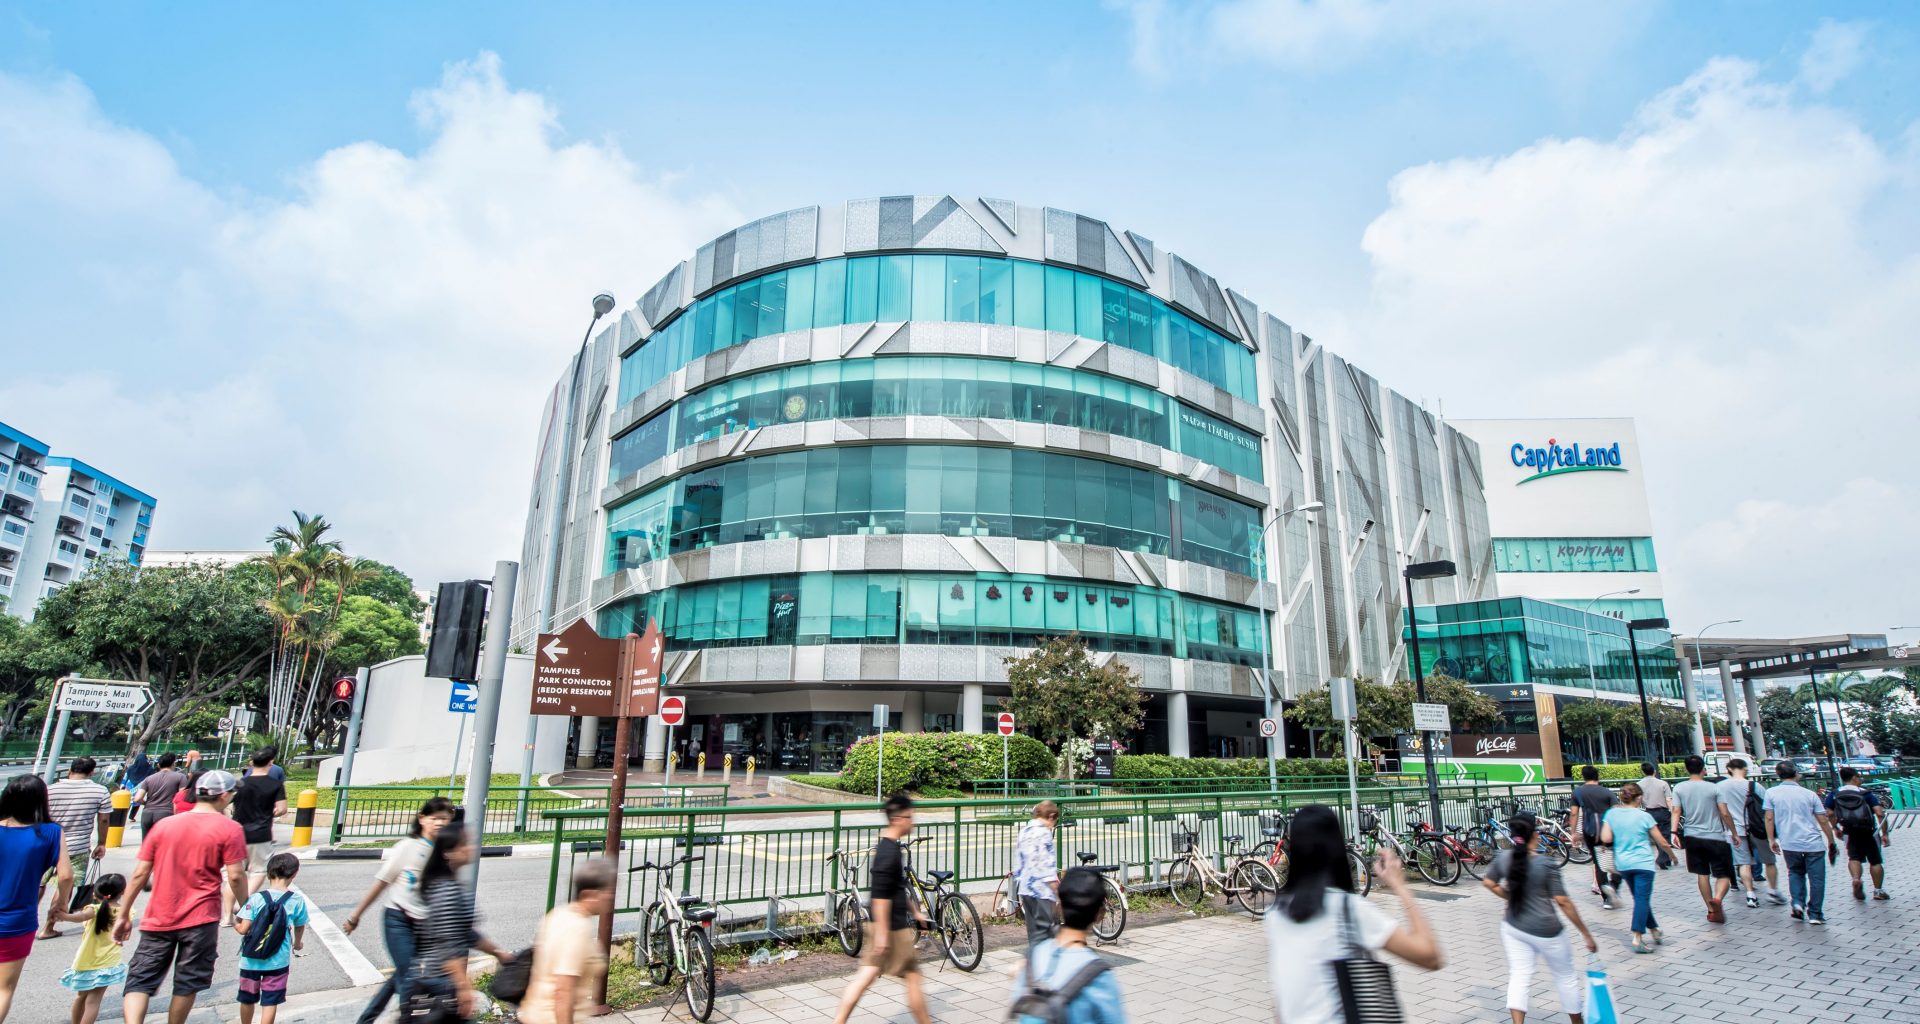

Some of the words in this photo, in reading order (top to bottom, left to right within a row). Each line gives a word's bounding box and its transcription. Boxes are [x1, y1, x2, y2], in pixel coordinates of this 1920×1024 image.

[1511, 438, 1621, 473] CapitaLand
[1557, 545, 1625, 558] KOPITIAM
[774, 602, 794, 613] Pizza
[777, 608, 793, 618] Hut
[540, 666, 581, 675] TAMPINES
[562, 678, 612, 686] CONNECTOR
[68, 687, 108, 697] Tampines
[113, 690, 131, 698] Mall
[537, 687, 569, 695] (BEDOK
[570, 688, 612, 697] RESERVOIR
[65, 697, 100, 708] Century
[105, 700, 135, 709] Square
[451, 702, 465, 710] ONE
[536, 697, 561, 705] PARK)
[1476, 736, 1517, 755] McCafé
